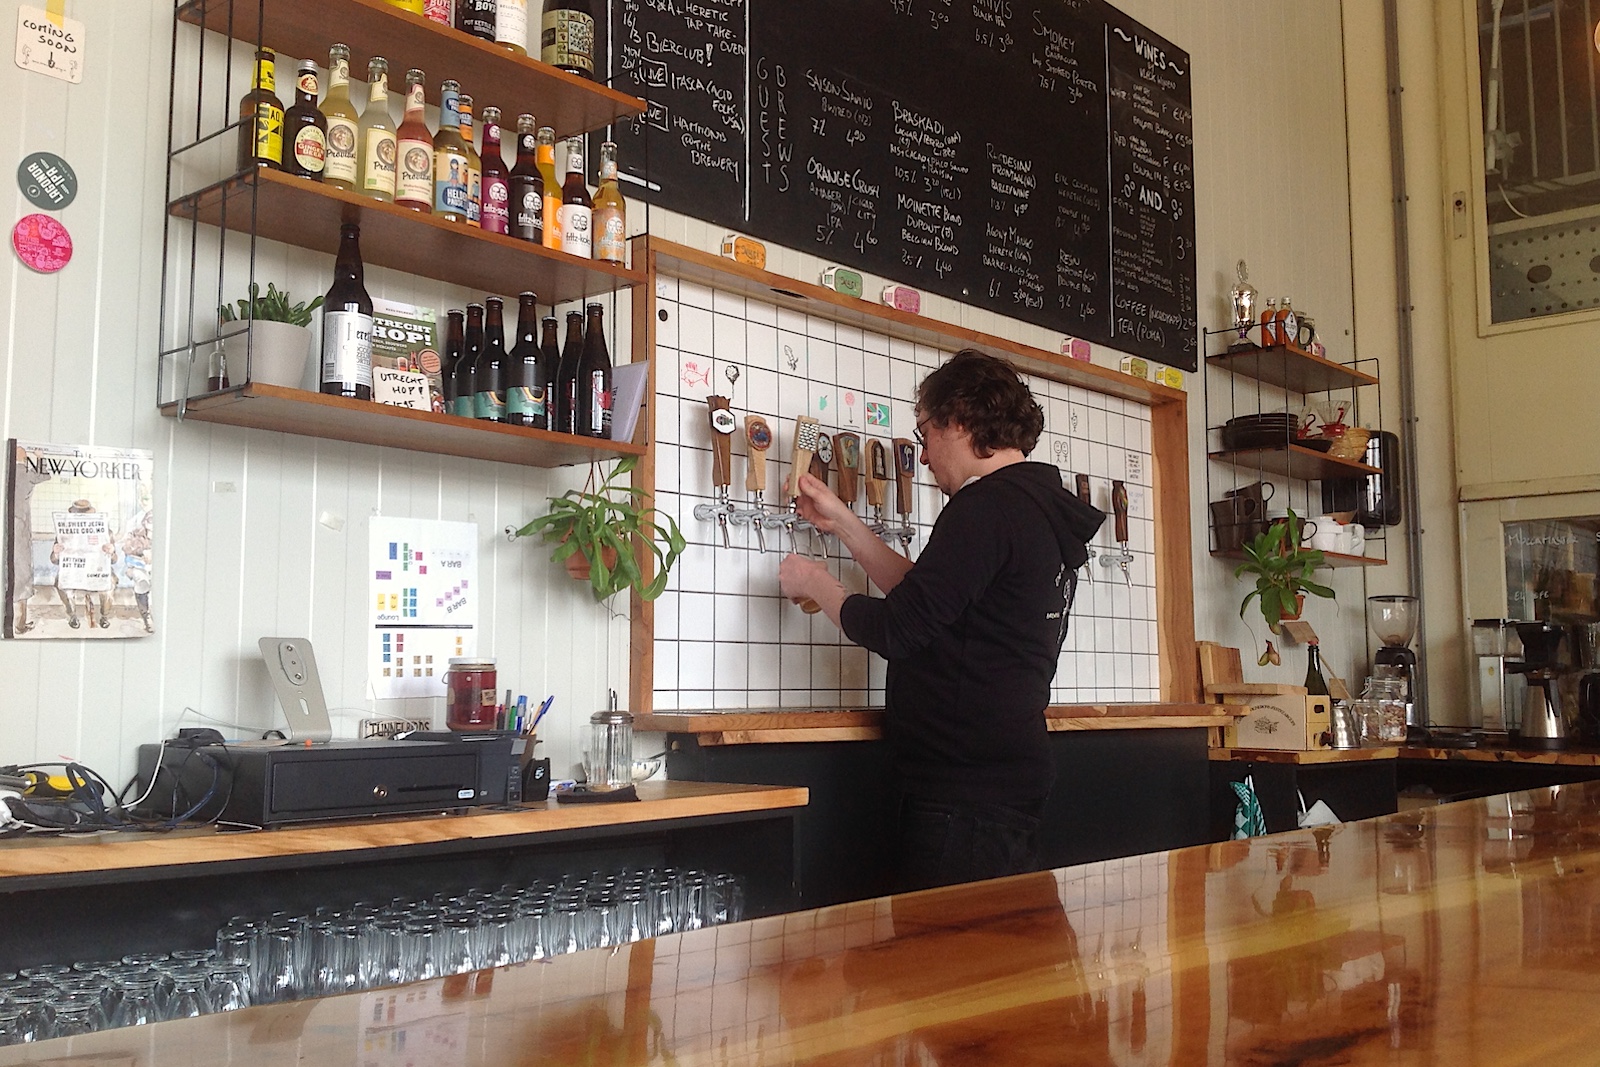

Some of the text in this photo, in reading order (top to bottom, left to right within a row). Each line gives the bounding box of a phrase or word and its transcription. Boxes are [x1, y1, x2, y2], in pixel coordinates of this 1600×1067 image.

[475, 1, 496, 12] BOYS
[626, 2, 639, 12] THU
[686, 2, 729, 21] HERETIC
[23, 19, 75, 43] COMING
[684, 16, 704, 31] TAP
[1032, 9, 1076, 53] SMOKEY
[37, 35, 77, 54] SOON
[720, 40, 746, 60] OVER
[806, 68, 841, 96] SAISON
[1072, 69, 1098, 93] PORTER
[891, 99, 944, 135] BRASKADI
[776, 64, 792, 196] BREWS
[691, 149, 740, 182] BREWERY
[807, 156, 880, 199] ORANGE CRUSH
[897, 193, 942, 220] MOINETTE
[906, 213, 941, 234] DUPONT
[902, 227, 960, 256] BELGIAN BLOND
[1115, 293, 1147, 317] COFFEE
[372, 316, 432, 334] TRECHT
[1117, 317, 1135, 337] TEA
[380, 373, 425, 385] UTRECHT
[26, 456, 142, 480] NEW YORKER
